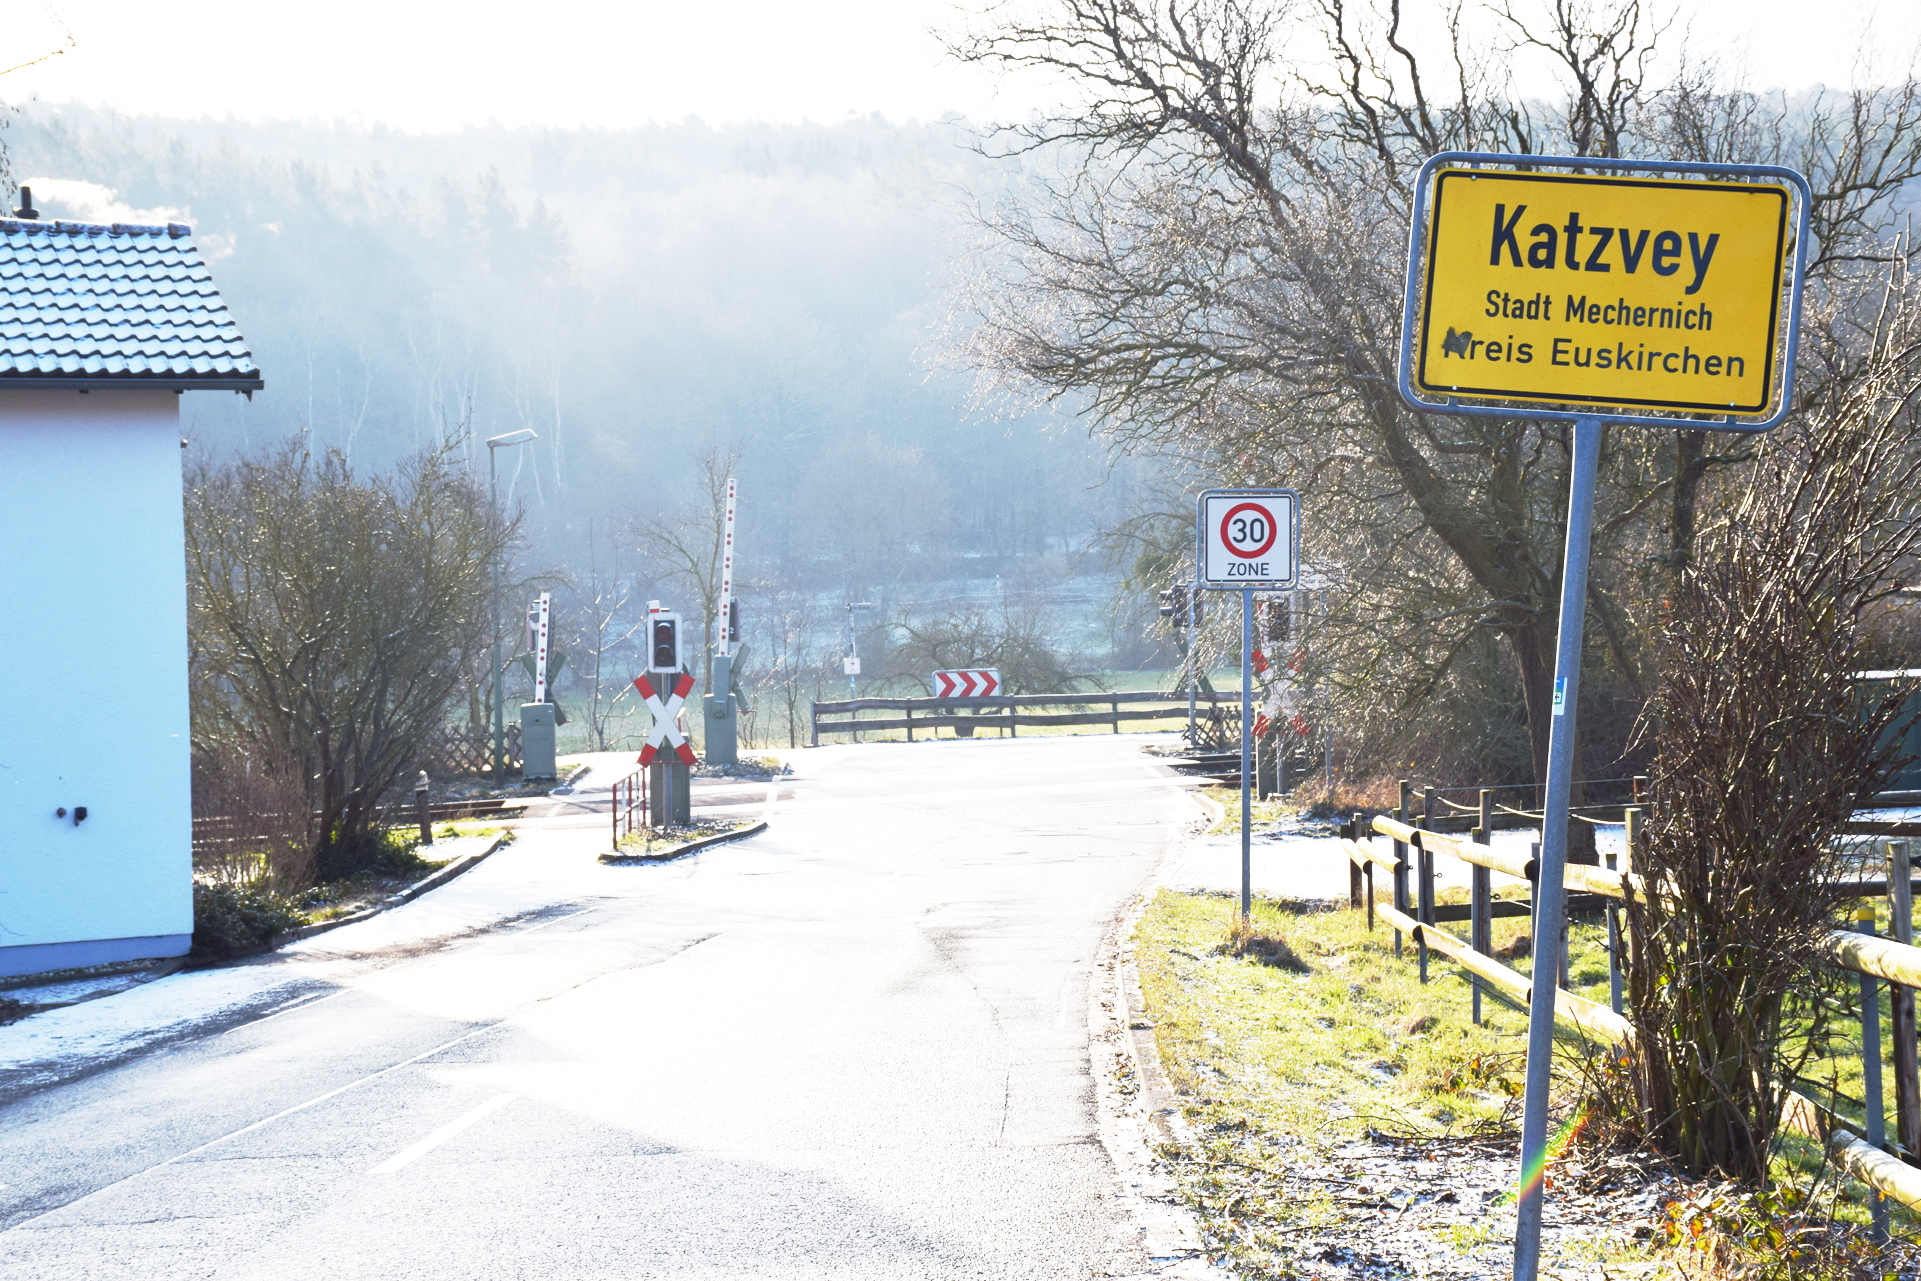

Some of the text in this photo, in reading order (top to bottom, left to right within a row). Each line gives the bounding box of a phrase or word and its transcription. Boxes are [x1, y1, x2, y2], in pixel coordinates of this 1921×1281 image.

[1489, 203, 1721, 295] Katzvey
[1485, 289, 1713, 331] Stadt Mechernich
[1442, 328, 1745, 378] reis Euskirchen
[1232, 517, 1265, 544] 30
[1227, 562, 1270, 576] ZONE
